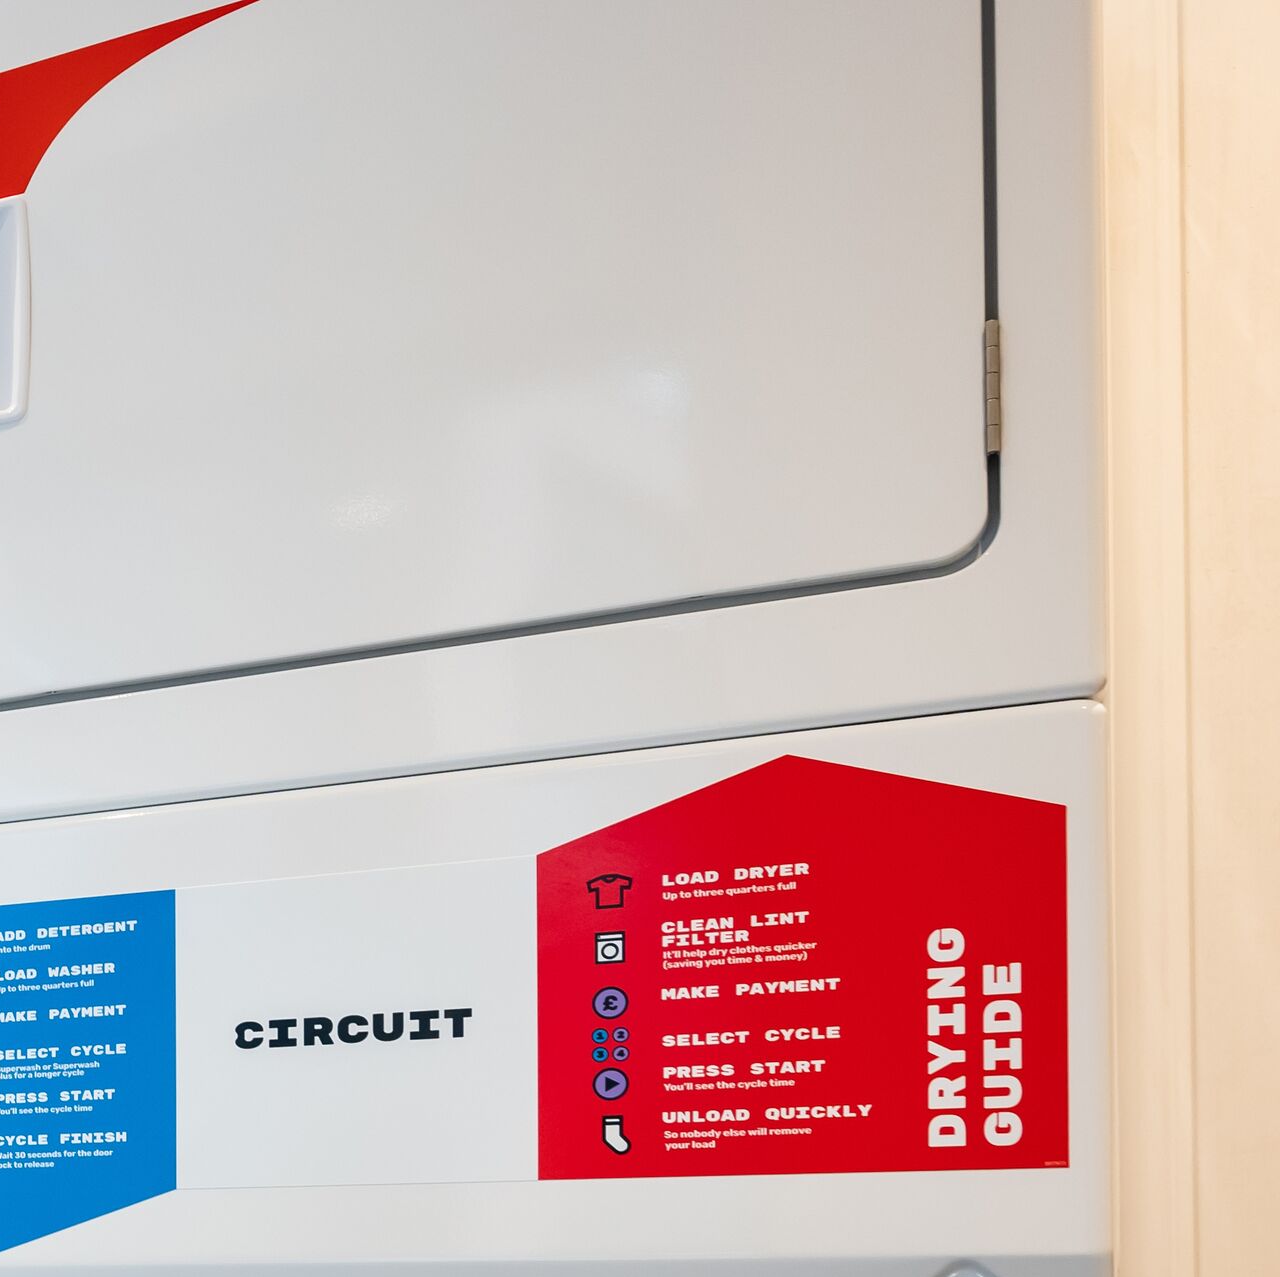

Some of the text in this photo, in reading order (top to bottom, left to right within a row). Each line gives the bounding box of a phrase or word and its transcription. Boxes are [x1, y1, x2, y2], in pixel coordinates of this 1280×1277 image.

[662, 863, 809, 886] LOAD DRYER
[663, 892, 678, 901] Up
[693, 888, 724, 897] three
[725, 885, 775, 896] quarters
[777, 882, 796, 890] full
[37, 920, 137, 938] DETERGENT
[661, 911, 809, 935] CLEAN LINT
[661, 927, 749, 947] FILTER
[48, 963, 115, 977] WASHER
[42, 982, 78, 991] quarters
[661, 978, 840, 1000] MAKE PAYMENT
[49, 1005, 126, 1019] PAYMENT
[235, 1008, 472, 1049] CIRCUIT
[662, 1026, 840, 1047] SELECT CYCLE
[927, 928, 966, 1147] DRYING
[71, 1043, 126, 1056] CYCLE
[983, 962, 1023, 1146] GUIDE
[663, 1060, 825, 1079] PRESS START
[60, 1089, 115, 1101] START
[662, 1104, 872, 1123] UNLOAD QUICKLY
[60, 1132, 127, 1144] FINISH
